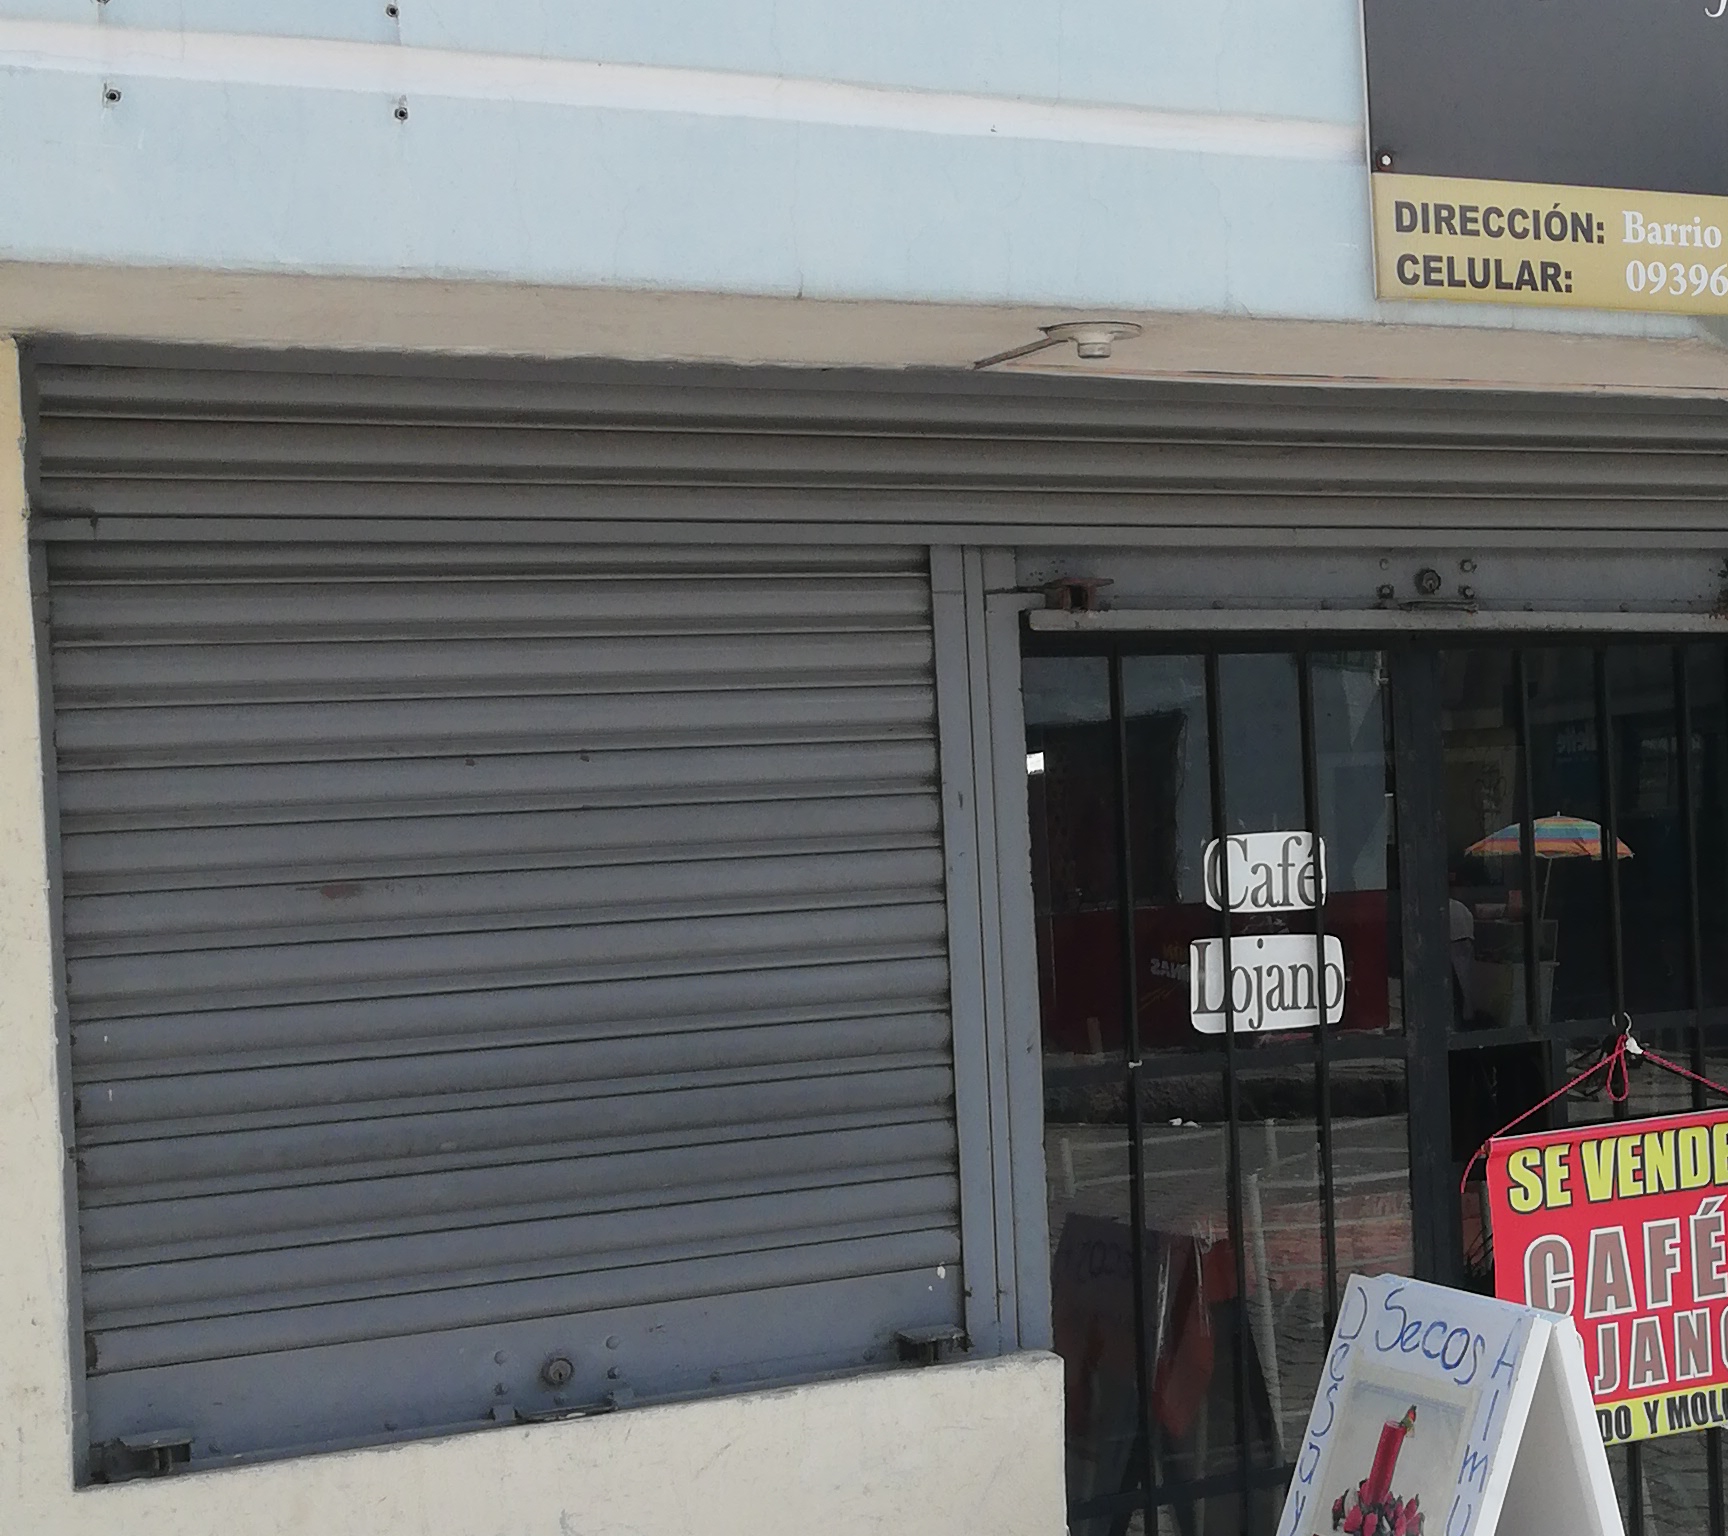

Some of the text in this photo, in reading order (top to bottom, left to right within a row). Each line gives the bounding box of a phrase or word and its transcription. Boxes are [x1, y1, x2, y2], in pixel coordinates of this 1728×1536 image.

[1394, 202, 1605, 244] DIRECCIÓN:
[1622, 210, 1721, 248] Barrio
[1396, 253, 1572, 293] CELULAR:
[1207, 835, 1324, 910] Café
[1191, 937, 1344, 1031] Lojano
[1507, 1143, 1572, 1214] SE
[1643, 1398, 1660, 1435] Y
